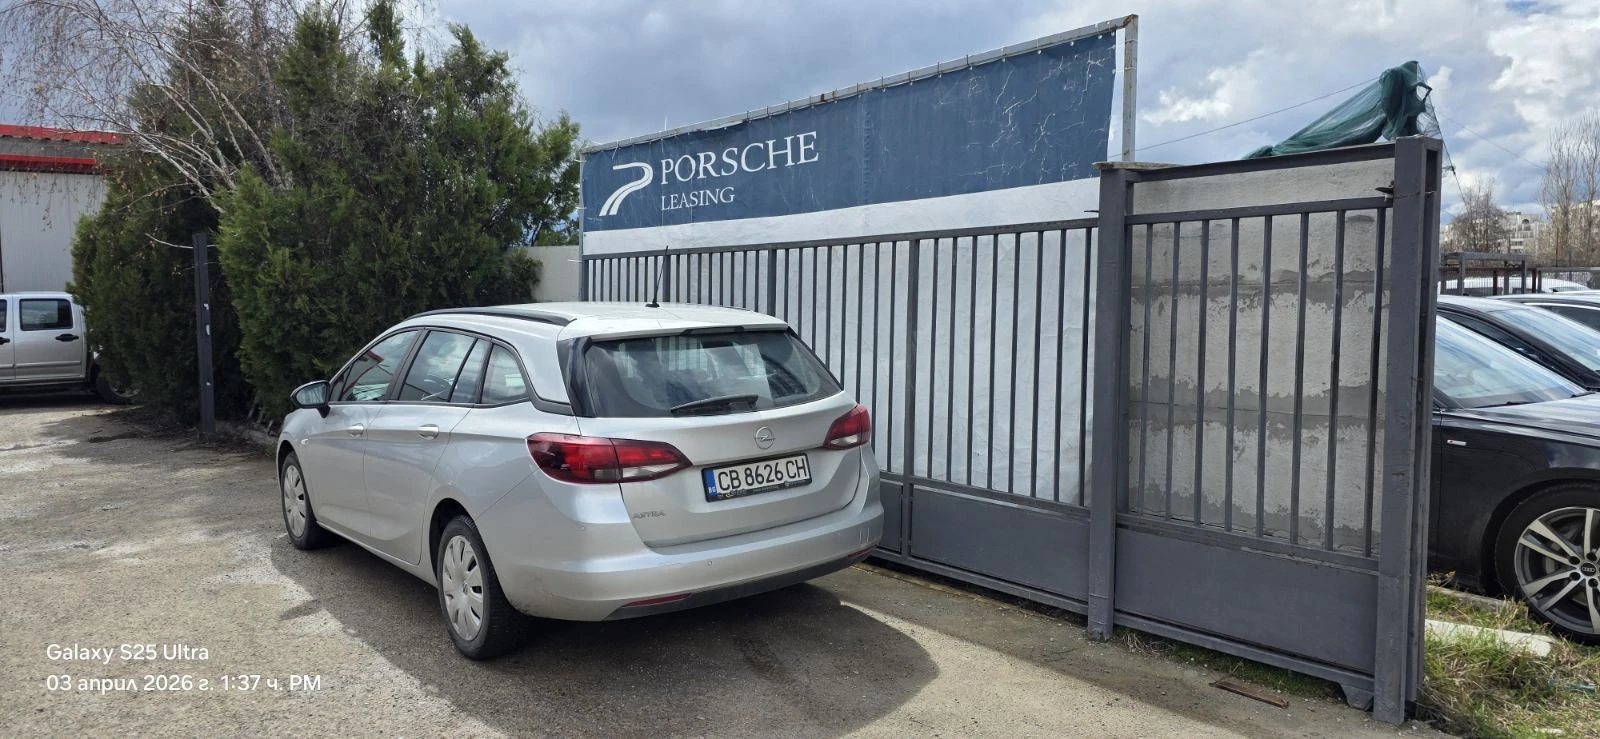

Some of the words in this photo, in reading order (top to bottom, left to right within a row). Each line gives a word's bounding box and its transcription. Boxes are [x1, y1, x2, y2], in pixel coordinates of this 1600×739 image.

[660, 130, 819, 185] PORSCHE
[661, 186, 735, 211] LEASING
[718, 469, 742, 491] CB
[744, 462, 784, 486] 8626
[785, 458, 808, 479] CH
